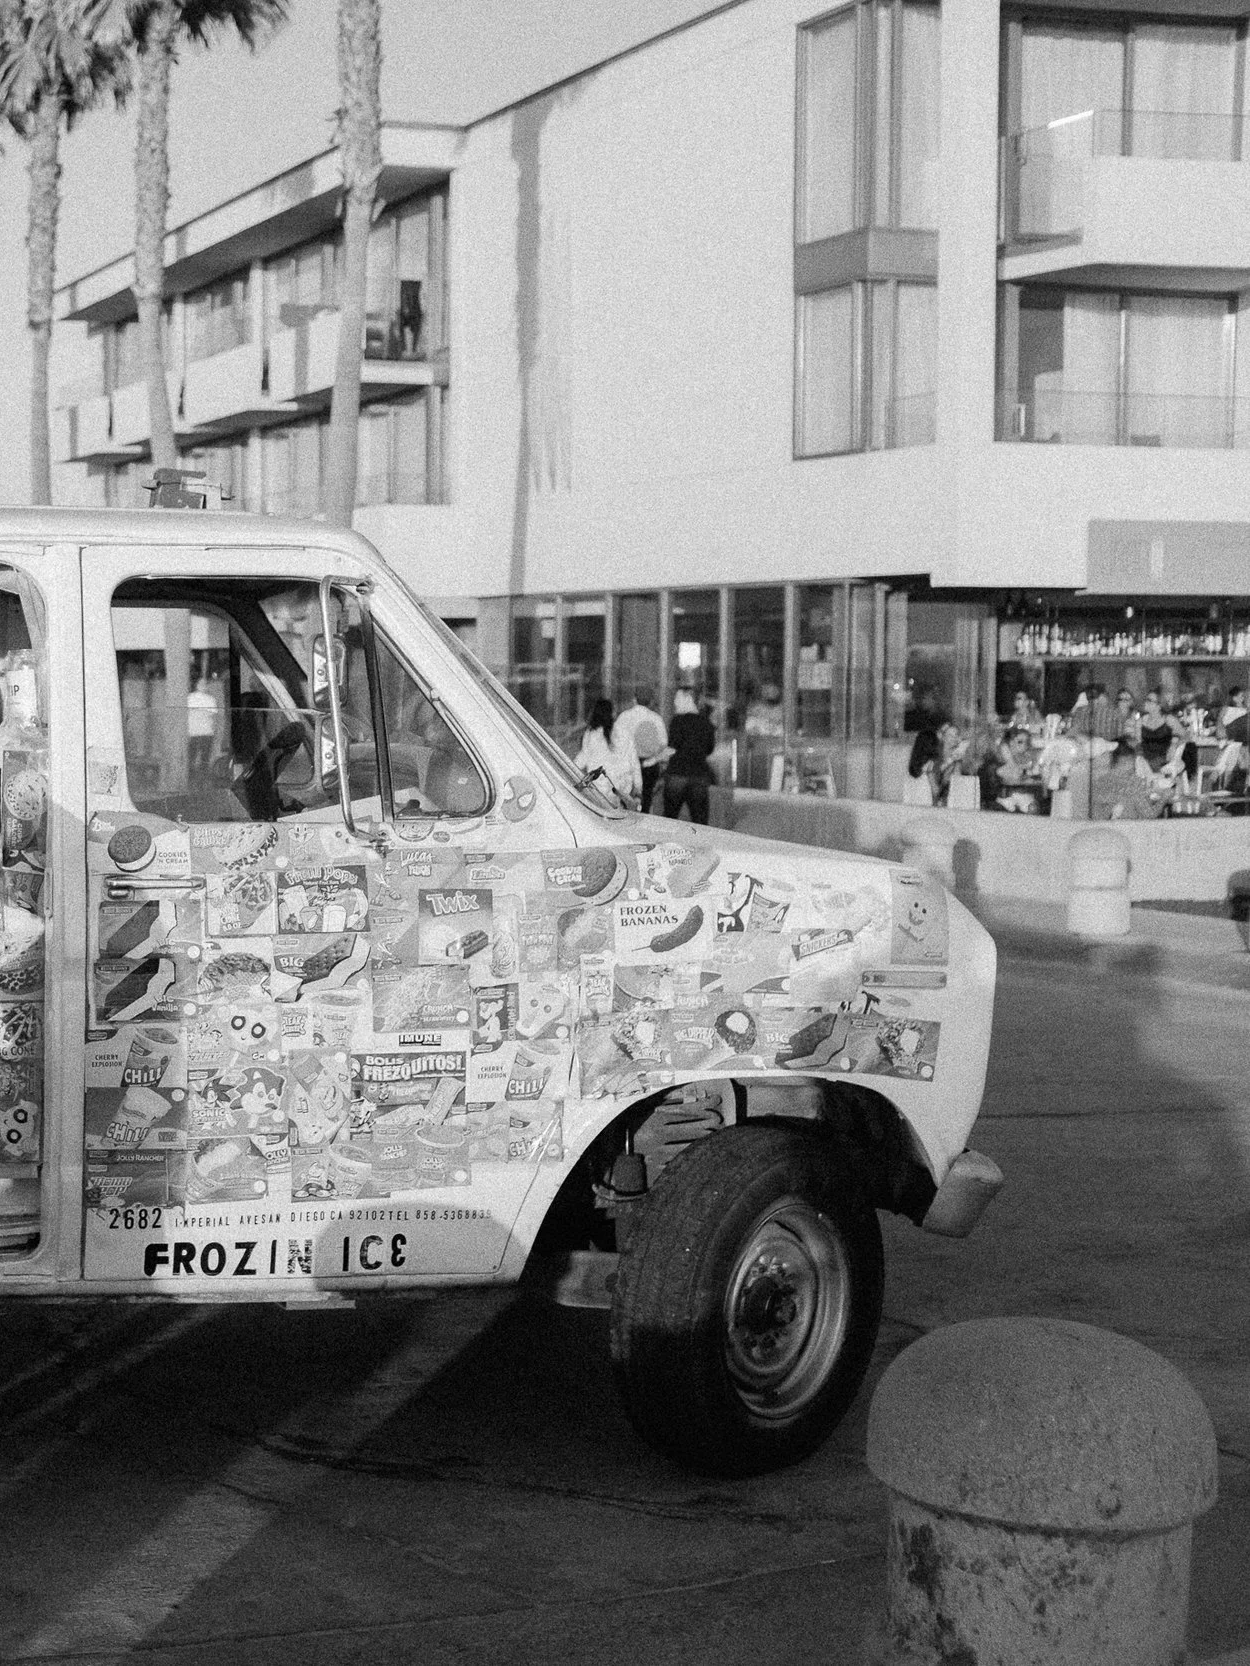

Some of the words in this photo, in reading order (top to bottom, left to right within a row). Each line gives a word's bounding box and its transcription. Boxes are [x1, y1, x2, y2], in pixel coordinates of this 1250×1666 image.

[400, 851, 434, 867] Lucas
[426, 892, 480, 916] Twix
[620, 904, 668, 916] FROZEN
[620, 915, 679, 927] BANANAS
[799, 935, 839, 954] SNICKERS
[279, 956, 305, 967] BIG
[765, 1032, 790, 1044] BIG
[365, 1055, 404, 1066] BOLIS
[135, 1153, 165, 1162] RANCHER
[108, 1207, 162, 1230] 2682
[290, 1211, 326, 1222] DIEGO
[330, 1210, 343, 1221] CA
[143, 1239, 313, 1277] FROZIN
